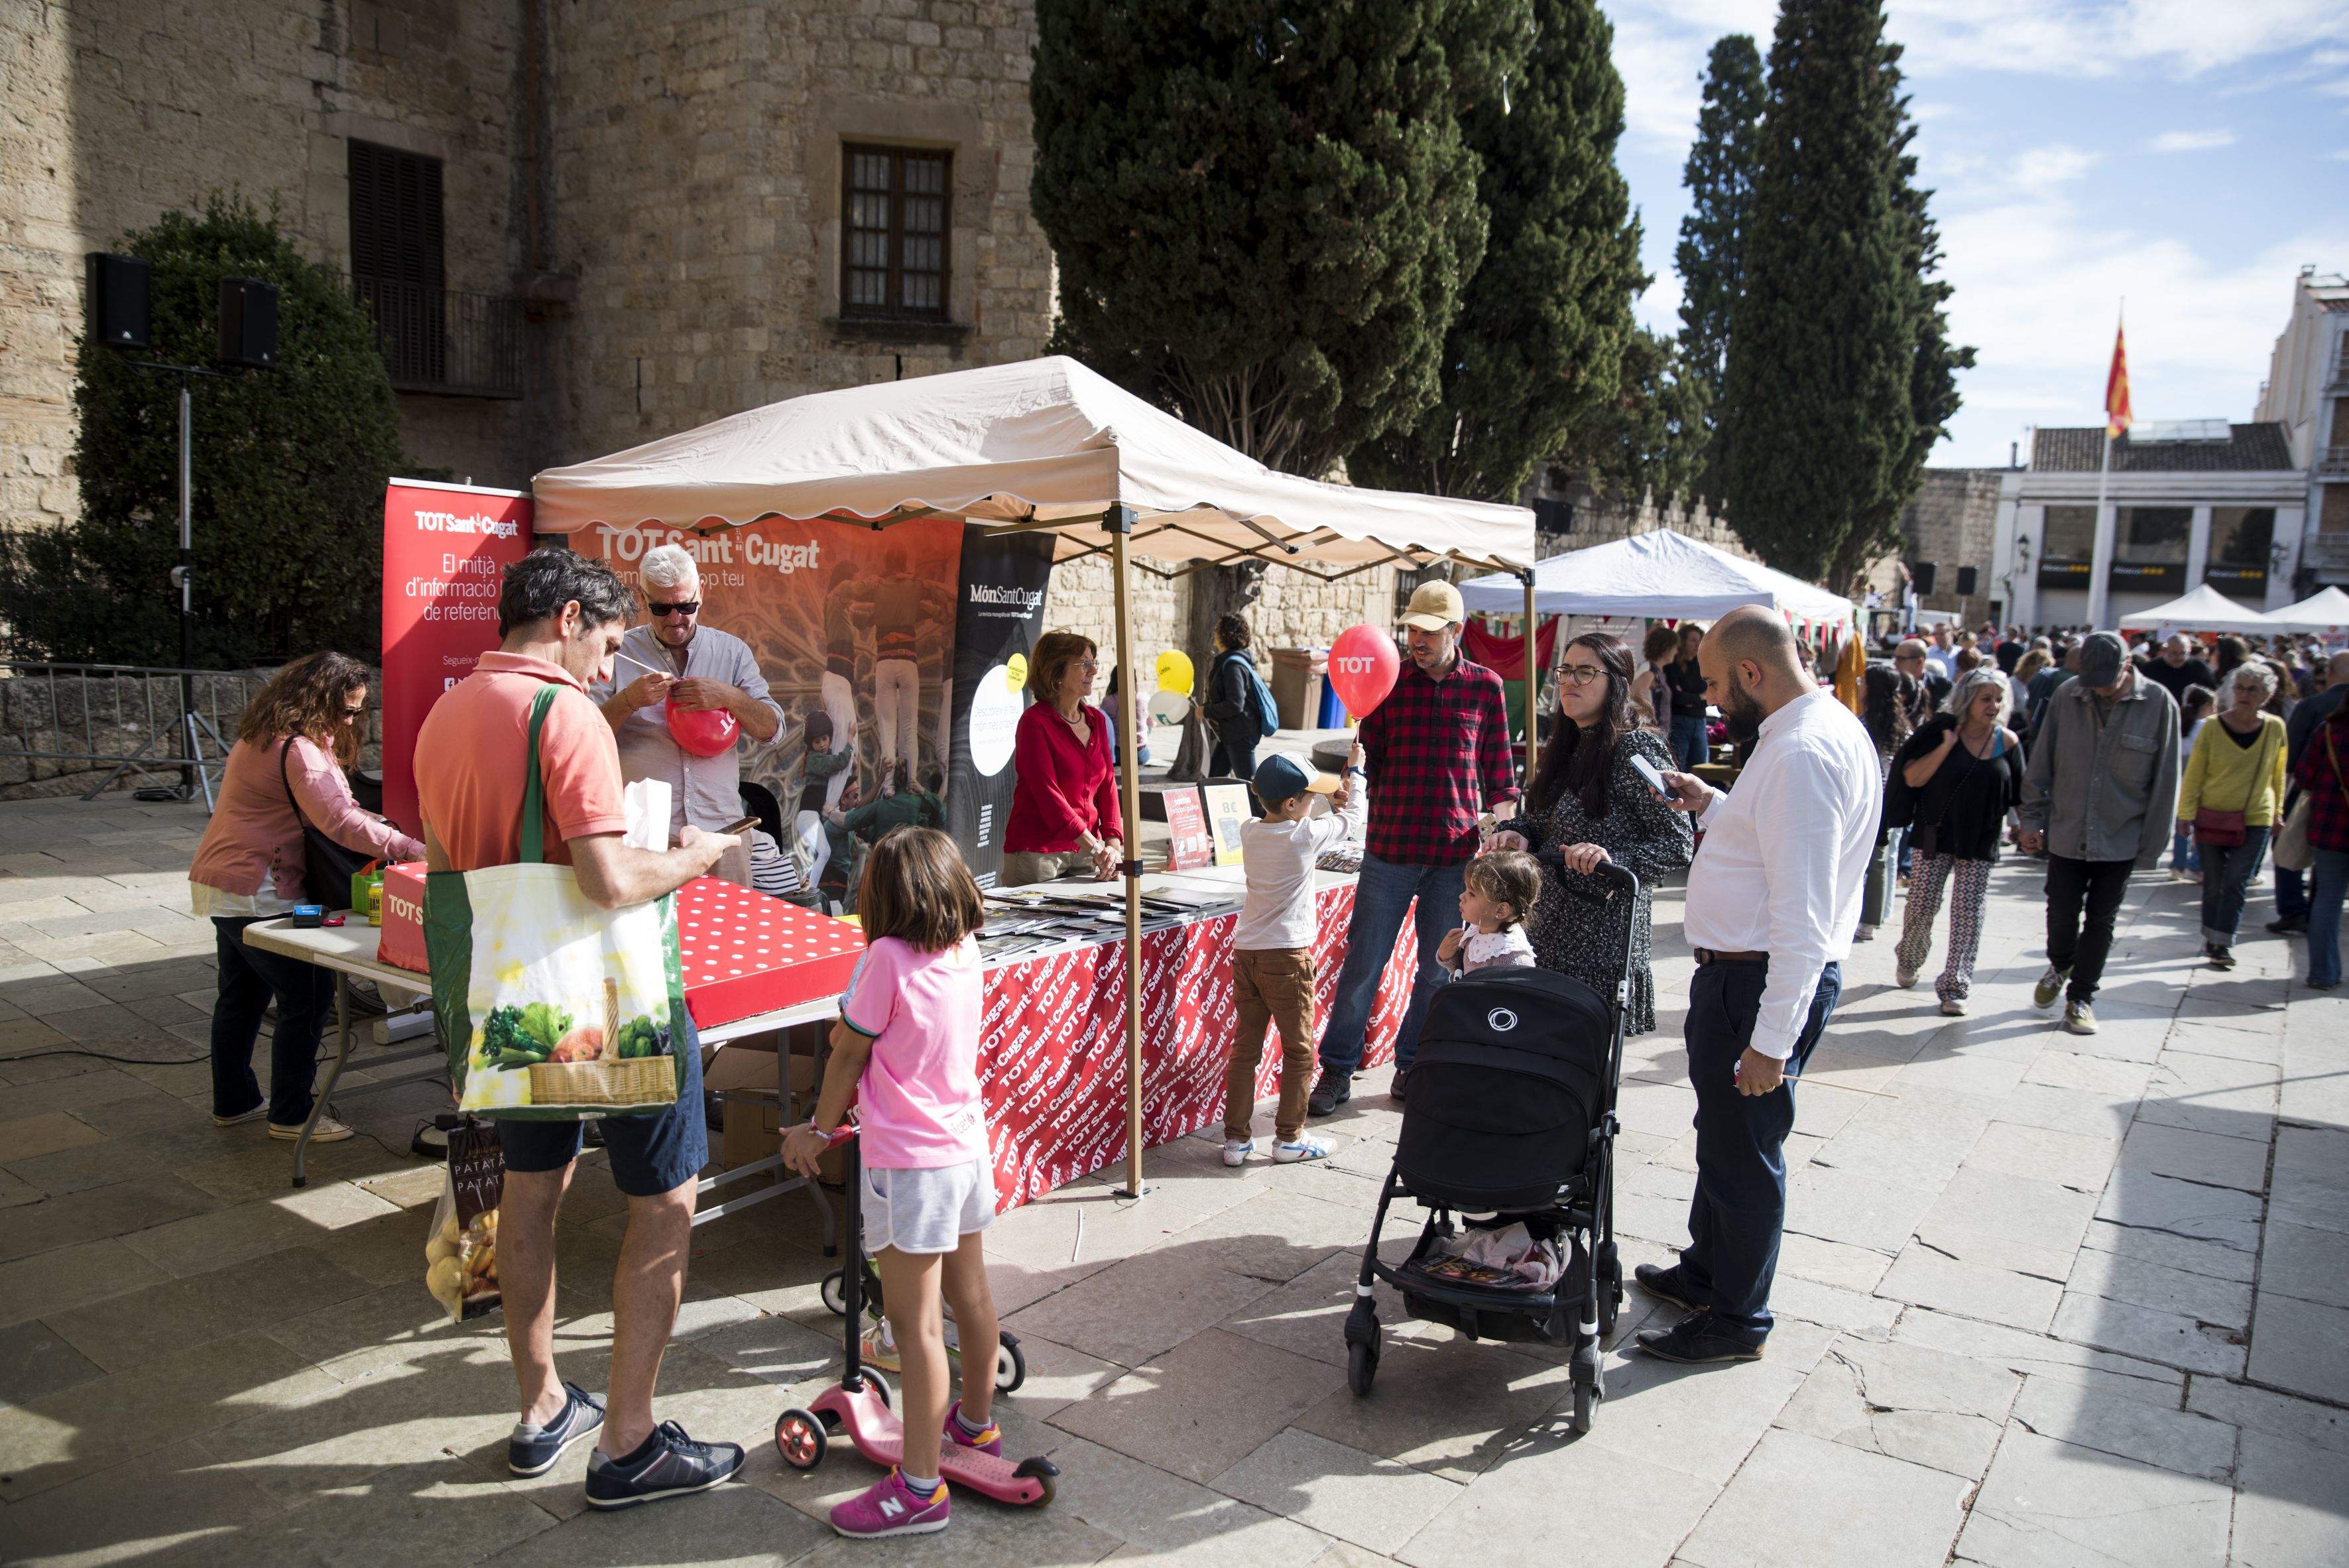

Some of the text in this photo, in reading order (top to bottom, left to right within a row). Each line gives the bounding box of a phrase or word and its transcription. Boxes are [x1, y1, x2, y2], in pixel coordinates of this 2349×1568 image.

[481, 515, 518, 539] Cugat
[443, 553, 495, 578] El mitjà
[745, 533, 820, 574] Cugat
[405, 576, 496, 597] d’informació
[722, 571, 745, 586] teu
[423, 601, 440, 621] de
[1337, 656, 1375, 674] TOT
[1221, 802, 1238, 814] 8€
[1324, 886, 1344, 919] Cugat
[1168, 922, 1205, 978] TOT Sant
[1036, 950, 1079, 1014] TOT Sant
[1056, 939, 1125, 1045] TOT Sant Cugat
[1103, 968, 1124, 1003] TOT
[1148, 959, 1165, 992] Sant
[1187, 976, 1203, 1006] TOT
[1203, 950, 1221, 981] Sant
[1315, 979, 1331, 1005] TOT
[1148, 988, 1168, 1028] Cugat
[1152, 948, 1207, 1048] TOT Sant Cugat
[1213, 991, 1230, 1022] TOT
[1369, 1002, 1390, 1028] Sant
[978, 1024, 1006, 1057] TOT
[1005, 993, 1032, 1028] Sant
[998, 981, 1081, 1087] TOT Sant Cugat
[1170, 977, 1221, 1073] TOT Sant Cugat
[1364, 1025, 1389, 1054] Cugat
[997, 1024, 1032, 1067] Cugat
[1018, 1013, 1101, 1115] TOT Sant Cugat
[1086, 1028, 1110, 1062] TOT
[1144, 1016, 1187, 1088] Sant Cugat
[1160, 1071, 1186, 1096] Sant
[1190, 1032, 1212, 1069] Cugat
[1186, 1031, 1227, 1085] TOT Sant
[986, 1055, 1052, 1130] Sant Cugat
[1050, 1030, 1127, 1130] TOT Sant Cugat
[1193, 1078, 1215, 1104] TOT
[1202, 1075, 1224, 1109] Cugat
[1002, 1071, 1081, 1176] TOT Sant Cugat
[1065, 1097, 1117, 1152] TOT Sant
[1153, 1091, 1177, 1128] Cugat
[1156, 1115, 1172, 1146] TOT
[1170, 1091, 1193, 1118] Sant
[1036, 1138, 1064, 1170] Sant
[1066, 1099, 1099, 1136] Cugat
[1079, 1120, 1111, 1158] Cugat
[1102, 1118, 1126, 1148] Sant
[455, 1156, 506, 1176] PATATA
[1019, 1138, 1042, 1181] Cugat
[879, 1496, 904, 1517] N
